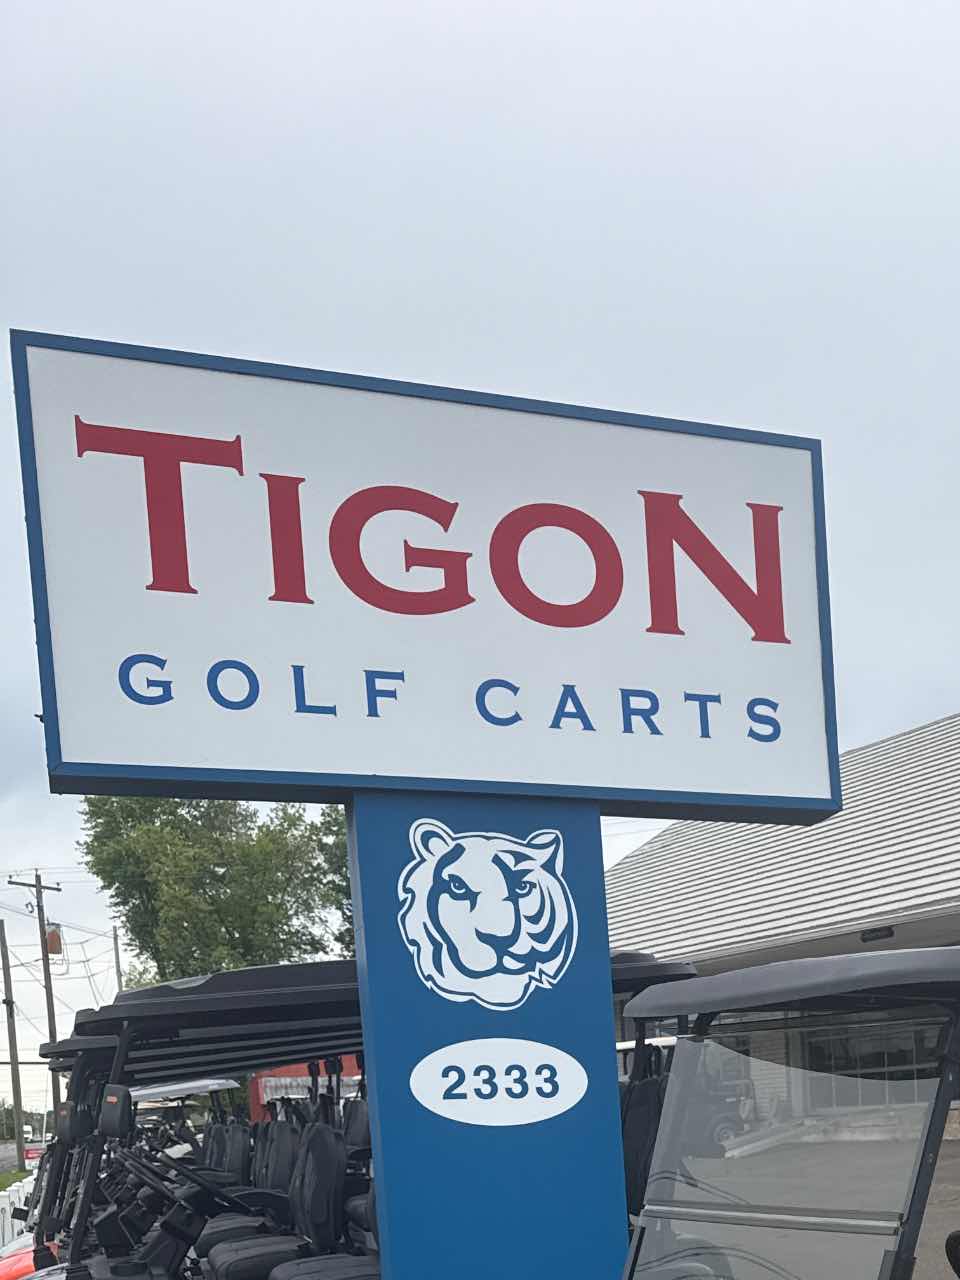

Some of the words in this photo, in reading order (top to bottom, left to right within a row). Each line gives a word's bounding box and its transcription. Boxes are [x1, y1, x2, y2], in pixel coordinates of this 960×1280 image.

[75, 414, 791, 645] TIGON
[118, 653, 405, 717] GOLF
[475, 679, 782, 743] CARTS
[441, 1064, 560, 1100] 2333
